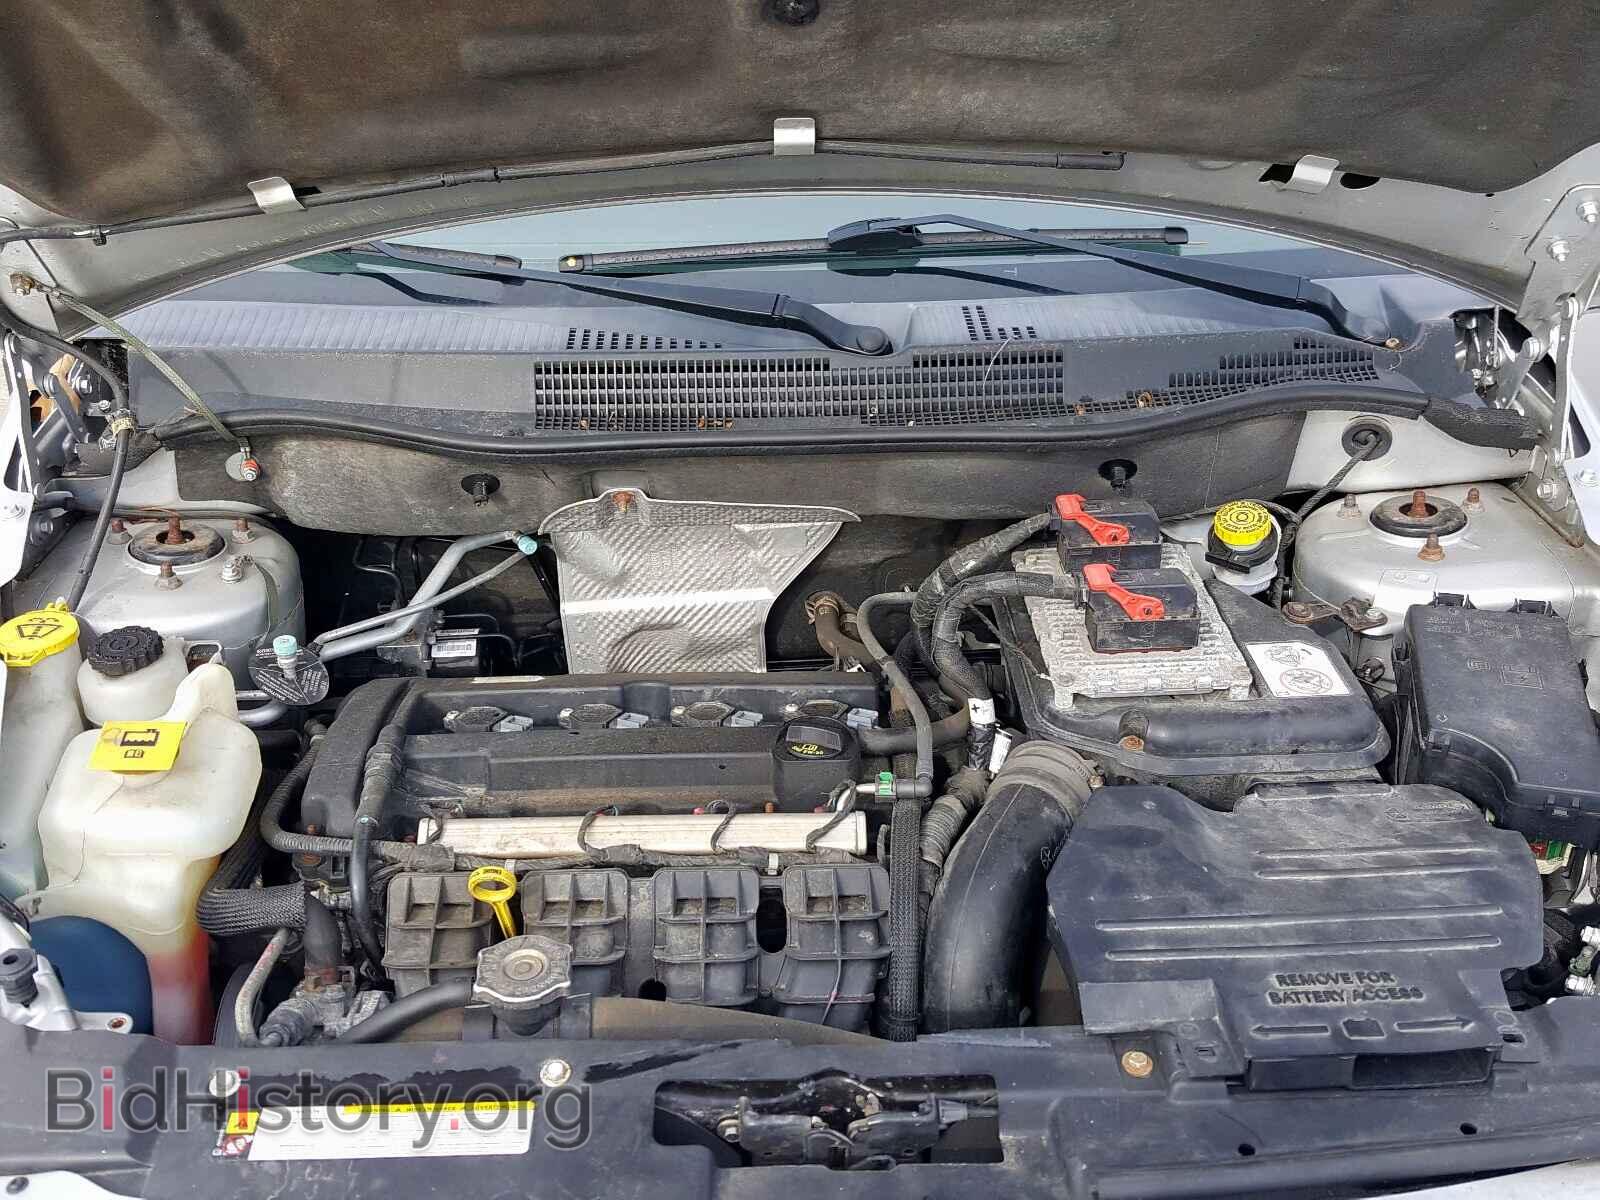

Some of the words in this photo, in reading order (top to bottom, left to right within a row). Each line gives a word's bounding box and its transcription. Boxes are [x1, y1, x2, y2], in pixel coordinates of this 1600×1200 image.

[1274, 971, 1353, 988] REMOVE
[1355, 970, 1396, 984] FOR
[1267, 989, 1346, 1005] BATTERY
[1351, 986, 1425, 1002] ACCESS
